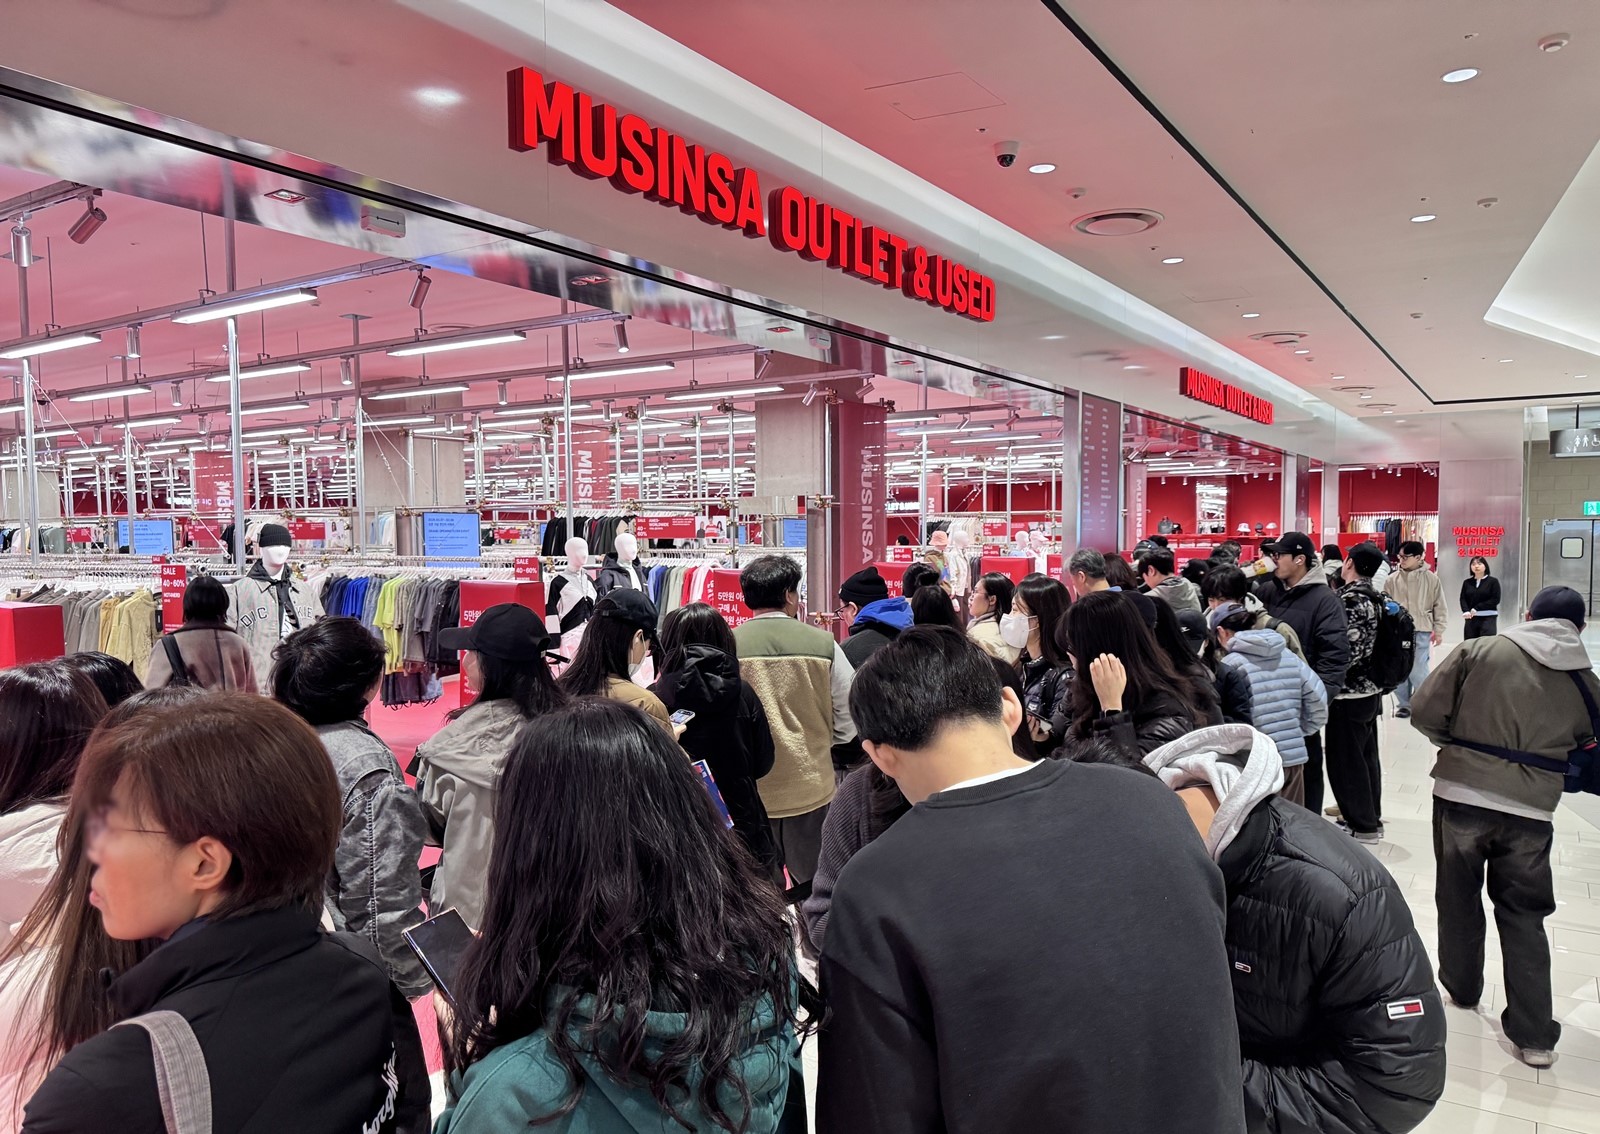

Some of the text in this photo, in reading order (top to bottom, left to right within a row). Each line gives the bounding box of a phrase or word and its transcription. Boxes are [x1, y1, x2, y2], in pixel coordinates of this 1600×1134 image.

[508, 66, 996, 323] MUSINSA OUTLET & USED
[1181, 366, 1274, 426] MUSINSA OUTLET & USED
[861, 448, 874, 564] MUSINSA
[1452, 526, 1505, 536] MUSINSA
[1456, 536, 1500, 546] OUTLET
[1457, 547, 1498, 557] & USED
[163, 567, 176, 575] SALE
[717, 591, 735, 602] 5만원
[717, 603, 730, 613] 구매
